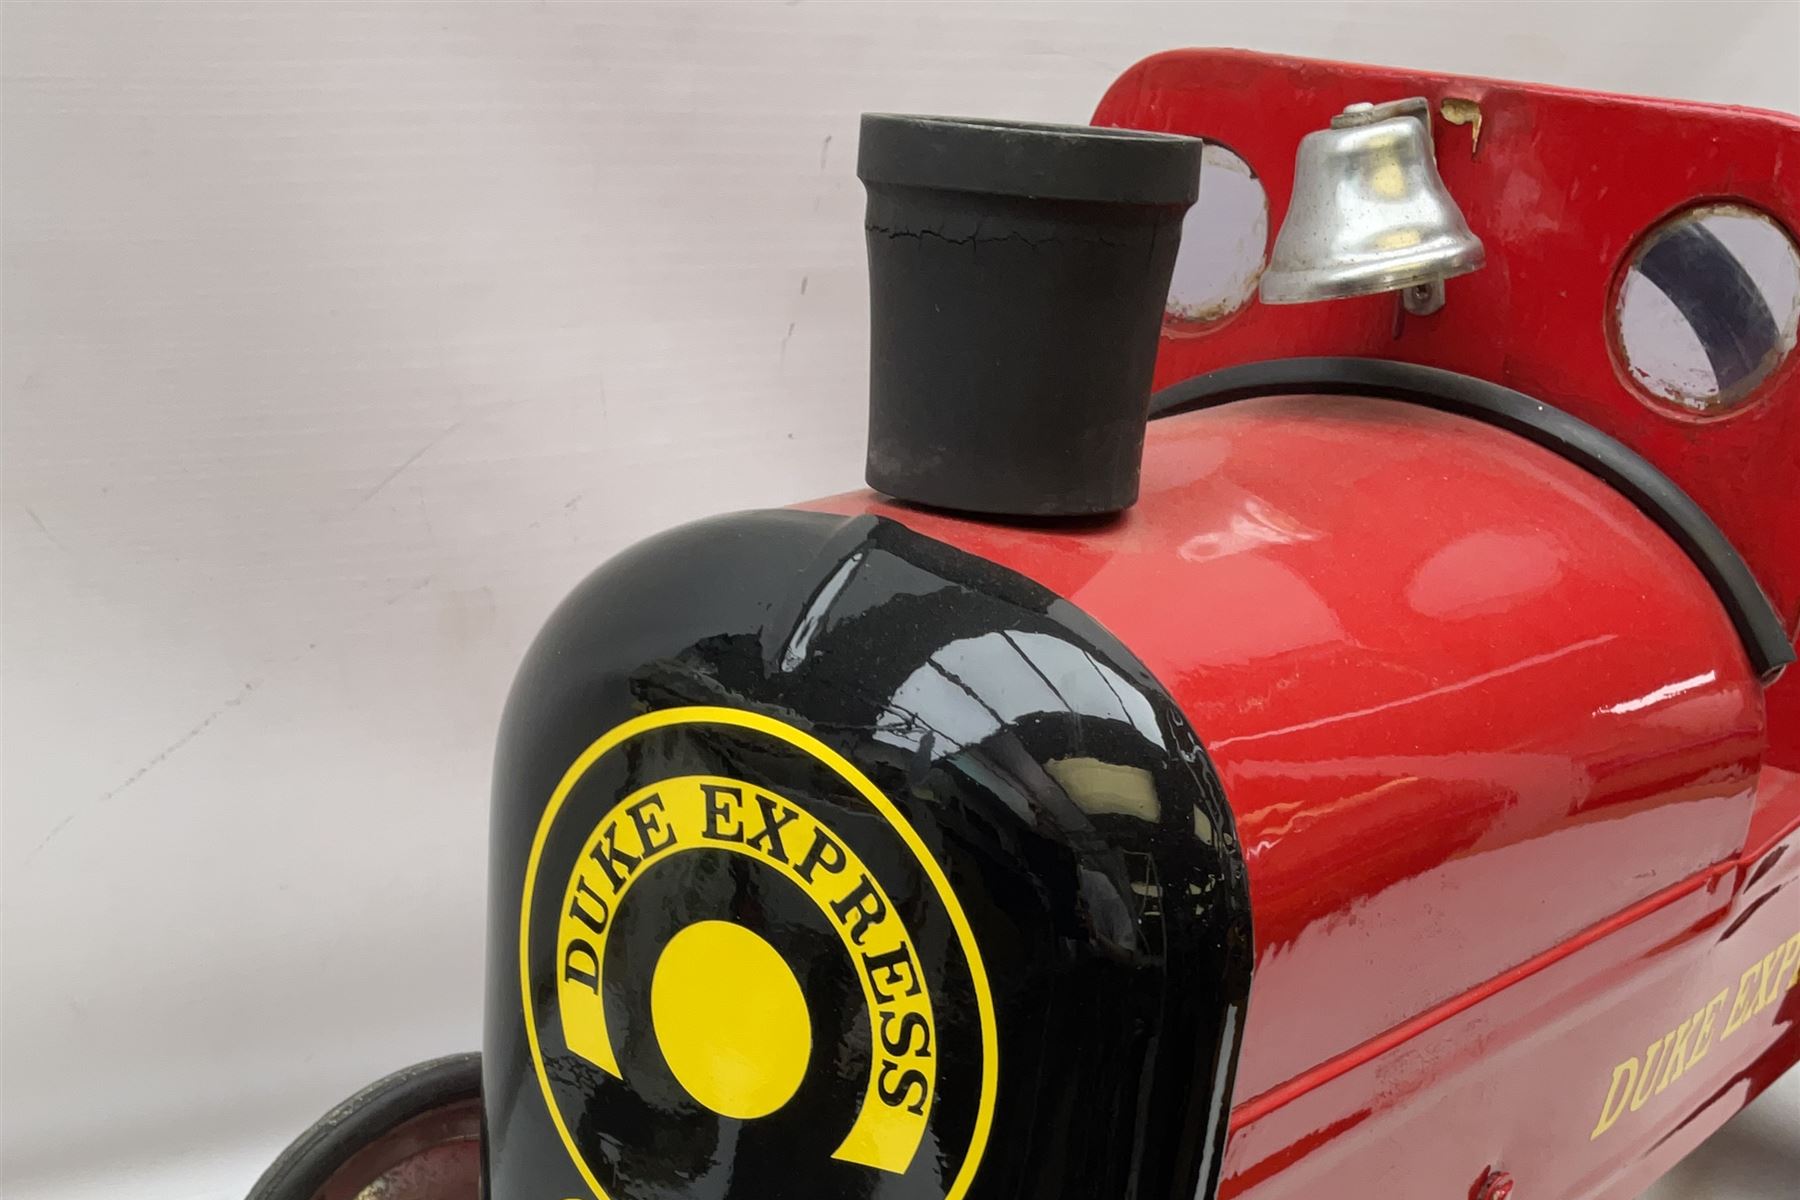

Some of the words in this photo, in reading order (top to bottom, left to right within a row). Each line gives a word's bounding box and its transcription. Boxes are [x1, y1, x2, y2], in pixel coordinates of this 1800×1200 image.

[565, 792, 677, 997] DUKE
[700, 784, 931, 1116] EXPRESS
[1590, 986, 1729, 1141] DUKE
[1720, 931, 1800, 1041] EXP
